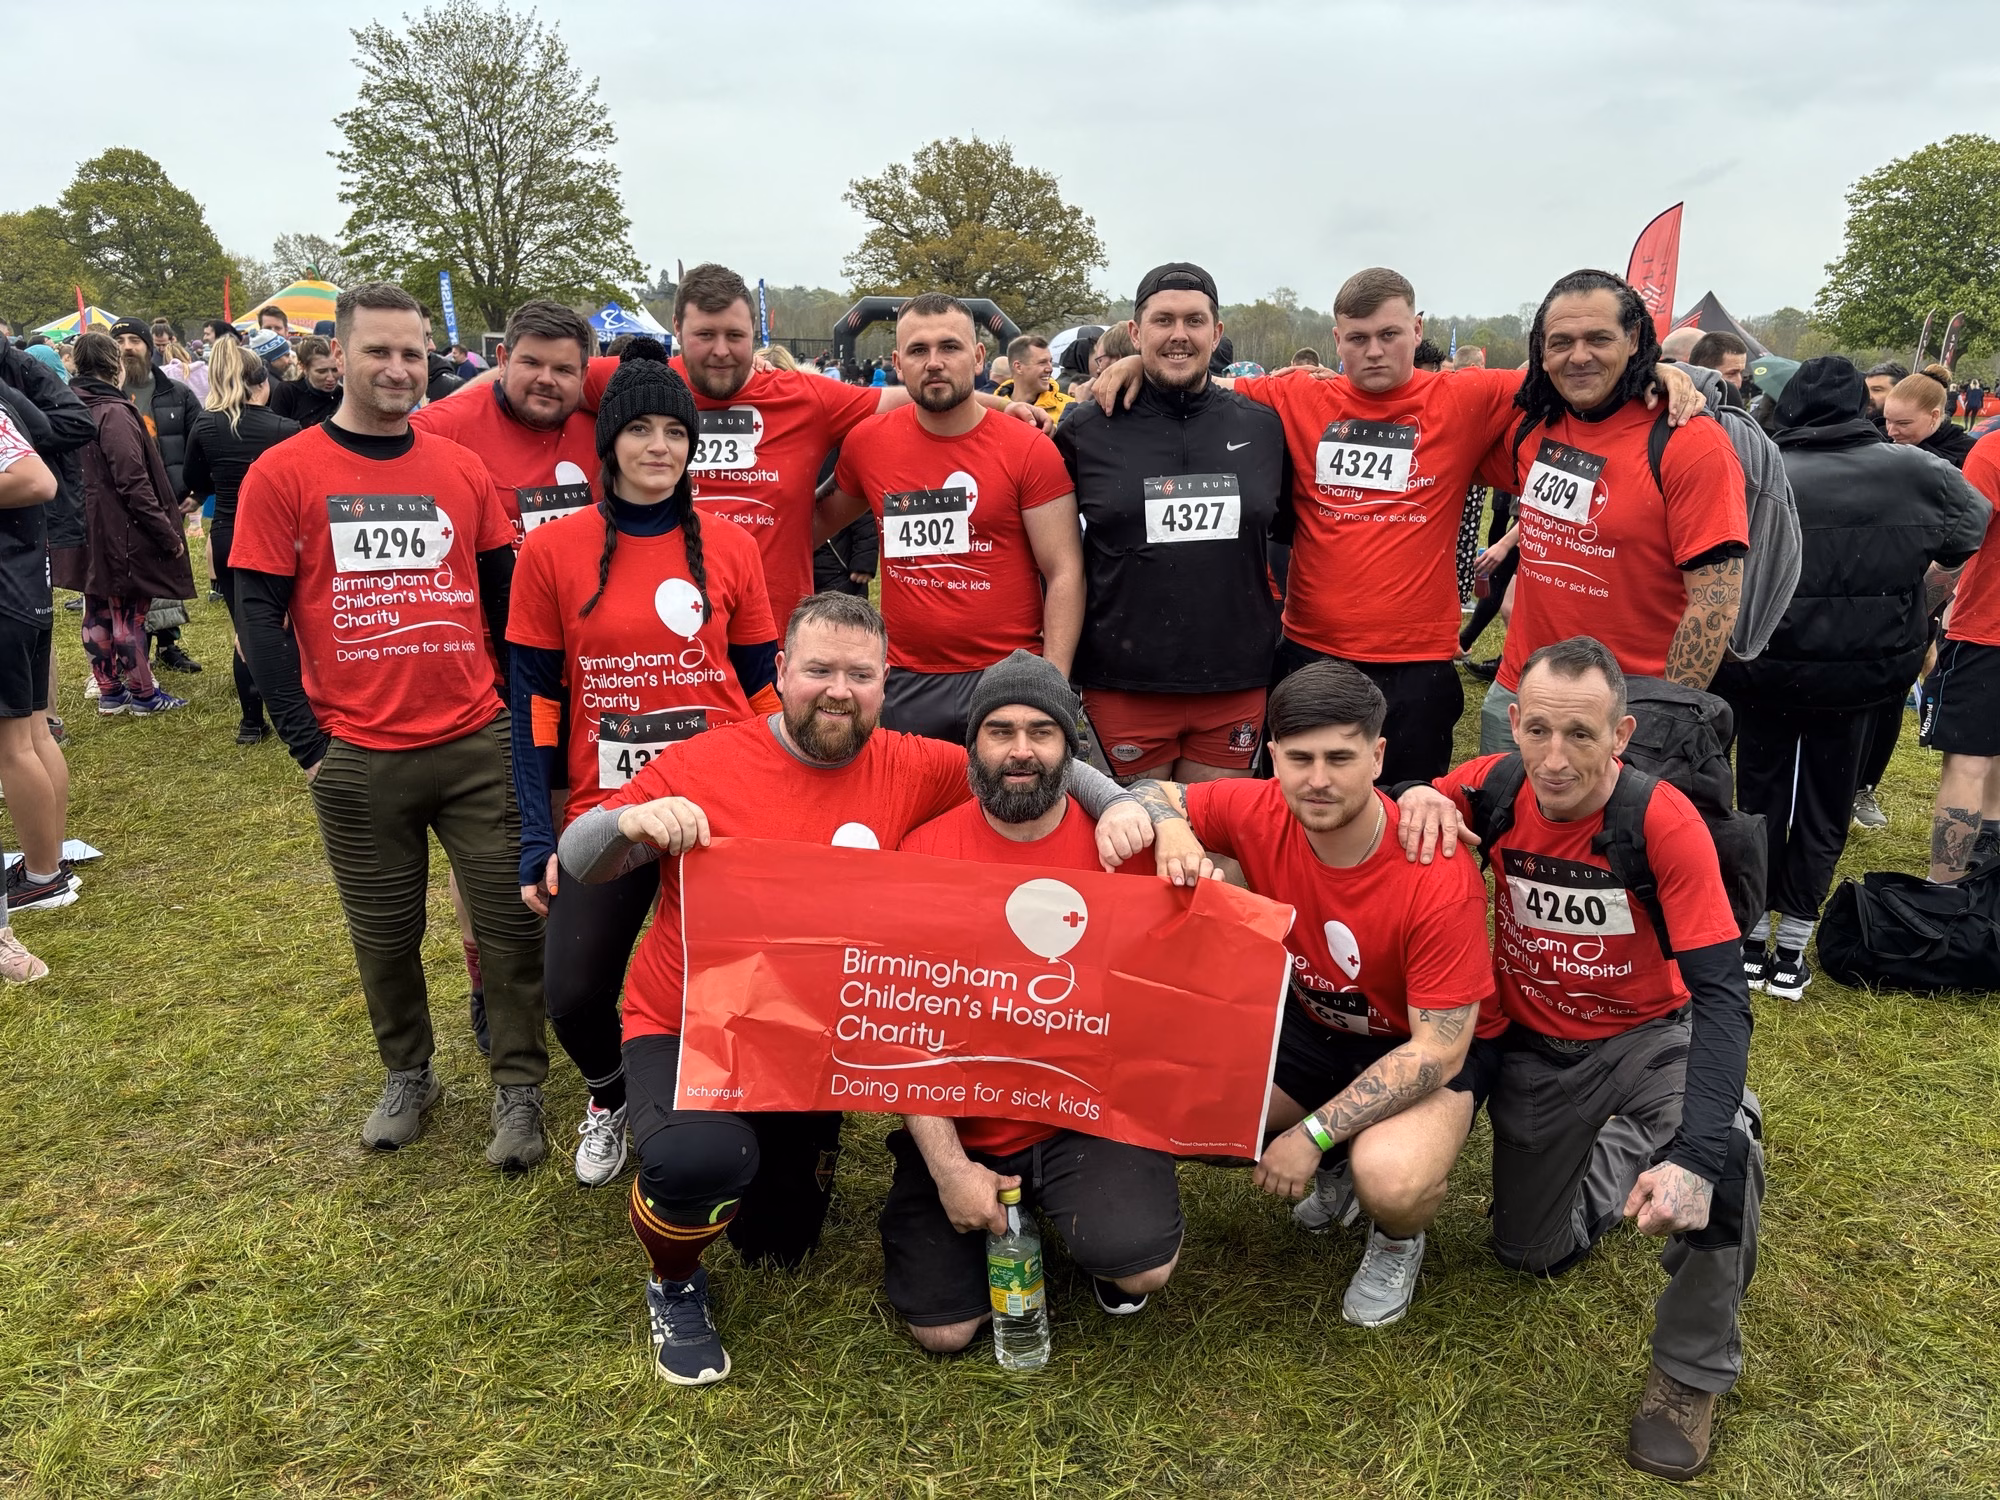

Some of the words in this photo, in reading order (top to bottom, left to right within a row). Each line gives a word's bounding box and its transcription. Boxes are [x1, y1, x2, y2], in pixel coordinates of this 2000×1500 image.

[1641, 256, 1654, 301] OLF
[1332, 427, 1368, 436] WOLF
[1378, 431, 1406, 440] RUN
[693, 439, 739, 464] 323
[1329, 448, 1393, 481] 4324
[1578, 459, 1599, 472] RUN
[526, 493, 557, 503] WOLF
[564, 491, 586, 500] RUN
[1155, 482, 1192, 491] WOLF
[1203, 481, 1231, 489] RUN
[1318, 484, 1364, 501] Charity
[1533, 472, 1579, 510] 4309
[341, 504, 386, 512] WOLF
[398, 503, 428, 511] RUN
[893, 498, 927, 508] WOLF
[935, 496, 959, 504] RUN
[734, 513, 753, 524] sick
[757, 514, 774, 526] kids
[1161, 502, 1225, 532] 4327
[1344, 512, 1370, 522] more
[1373, 513, 1387, 522] for
[1389, 513, 1406, 522] sick
[1409, 513, 1427, 523] kids
[354, 527, 426, 559] 4296
[899, 517, 955, 547] 4302
[1565, 536, 1616, 558] Hospital
[332, 572, 429, 592] Birmingham
[903, 576, 927, 587] more
[931, 578, 944, 588] for
[947, 580, 967, 590] sick
[971, 580, 991, 590] kids
[1531, 571, 1552, 584] more
[1555, 578, 1567, 588] for
[1569, 582, 1586, 594] sick
[1589, 586, 1609, 598] kids
[332, 591, 417, 611] Children's
[419, 589, 474, 605] Hospital
[333, 609, 400, 629] Charity
[336, 648, 379, 662] Doing
[383, 644, 419, 657] more
[423, 642, 439, 652] for
[443, 641, 460, 652] sick
[462, 640, 475, 651] kids
[578, 651, 674, 672] Birmingham
[582, 672, 658, 690] Children's
[663, 667, 726, 687] Hospital
[583, 693, 640, 711] Charity
[609, 722, 651, 734] WOLF
[665, 720, 698, 731] RUN
[1514, 858, 1557, 875] WOLF
[1571, 870, 1609, 879] RUN
[1526, 887, 1607, 926] 4260
[843, 947, 1018, 991] Birmingham
[1553, 956, 1632, 980] Hospital
[1743, 962, 1763, 974] NIKE
[1774, 972, 1797, 984] NIKE
[840, 981, 982, 1019] Children's
[991, 996, 1110, 1036] Hospital
[1520, 984, 1553, 1006] more
[1557, 1002, 1577, 1016] for
[1581, 1005, 1604, 1020] sick
[1315, 1006, 1349, 1029] 65
[836, 1014, 945, 1052] Charity
[687, 1085, 744, 1100] bch.org.uk
[831, 1074, 899, 1103] Doing
[907, 1082, 966, 1102] more
[974, 1082, 1004, 1103] for
[1011, 1087, 1052, 1110] sick
[1058, 1093, 1100, 1121] kids
